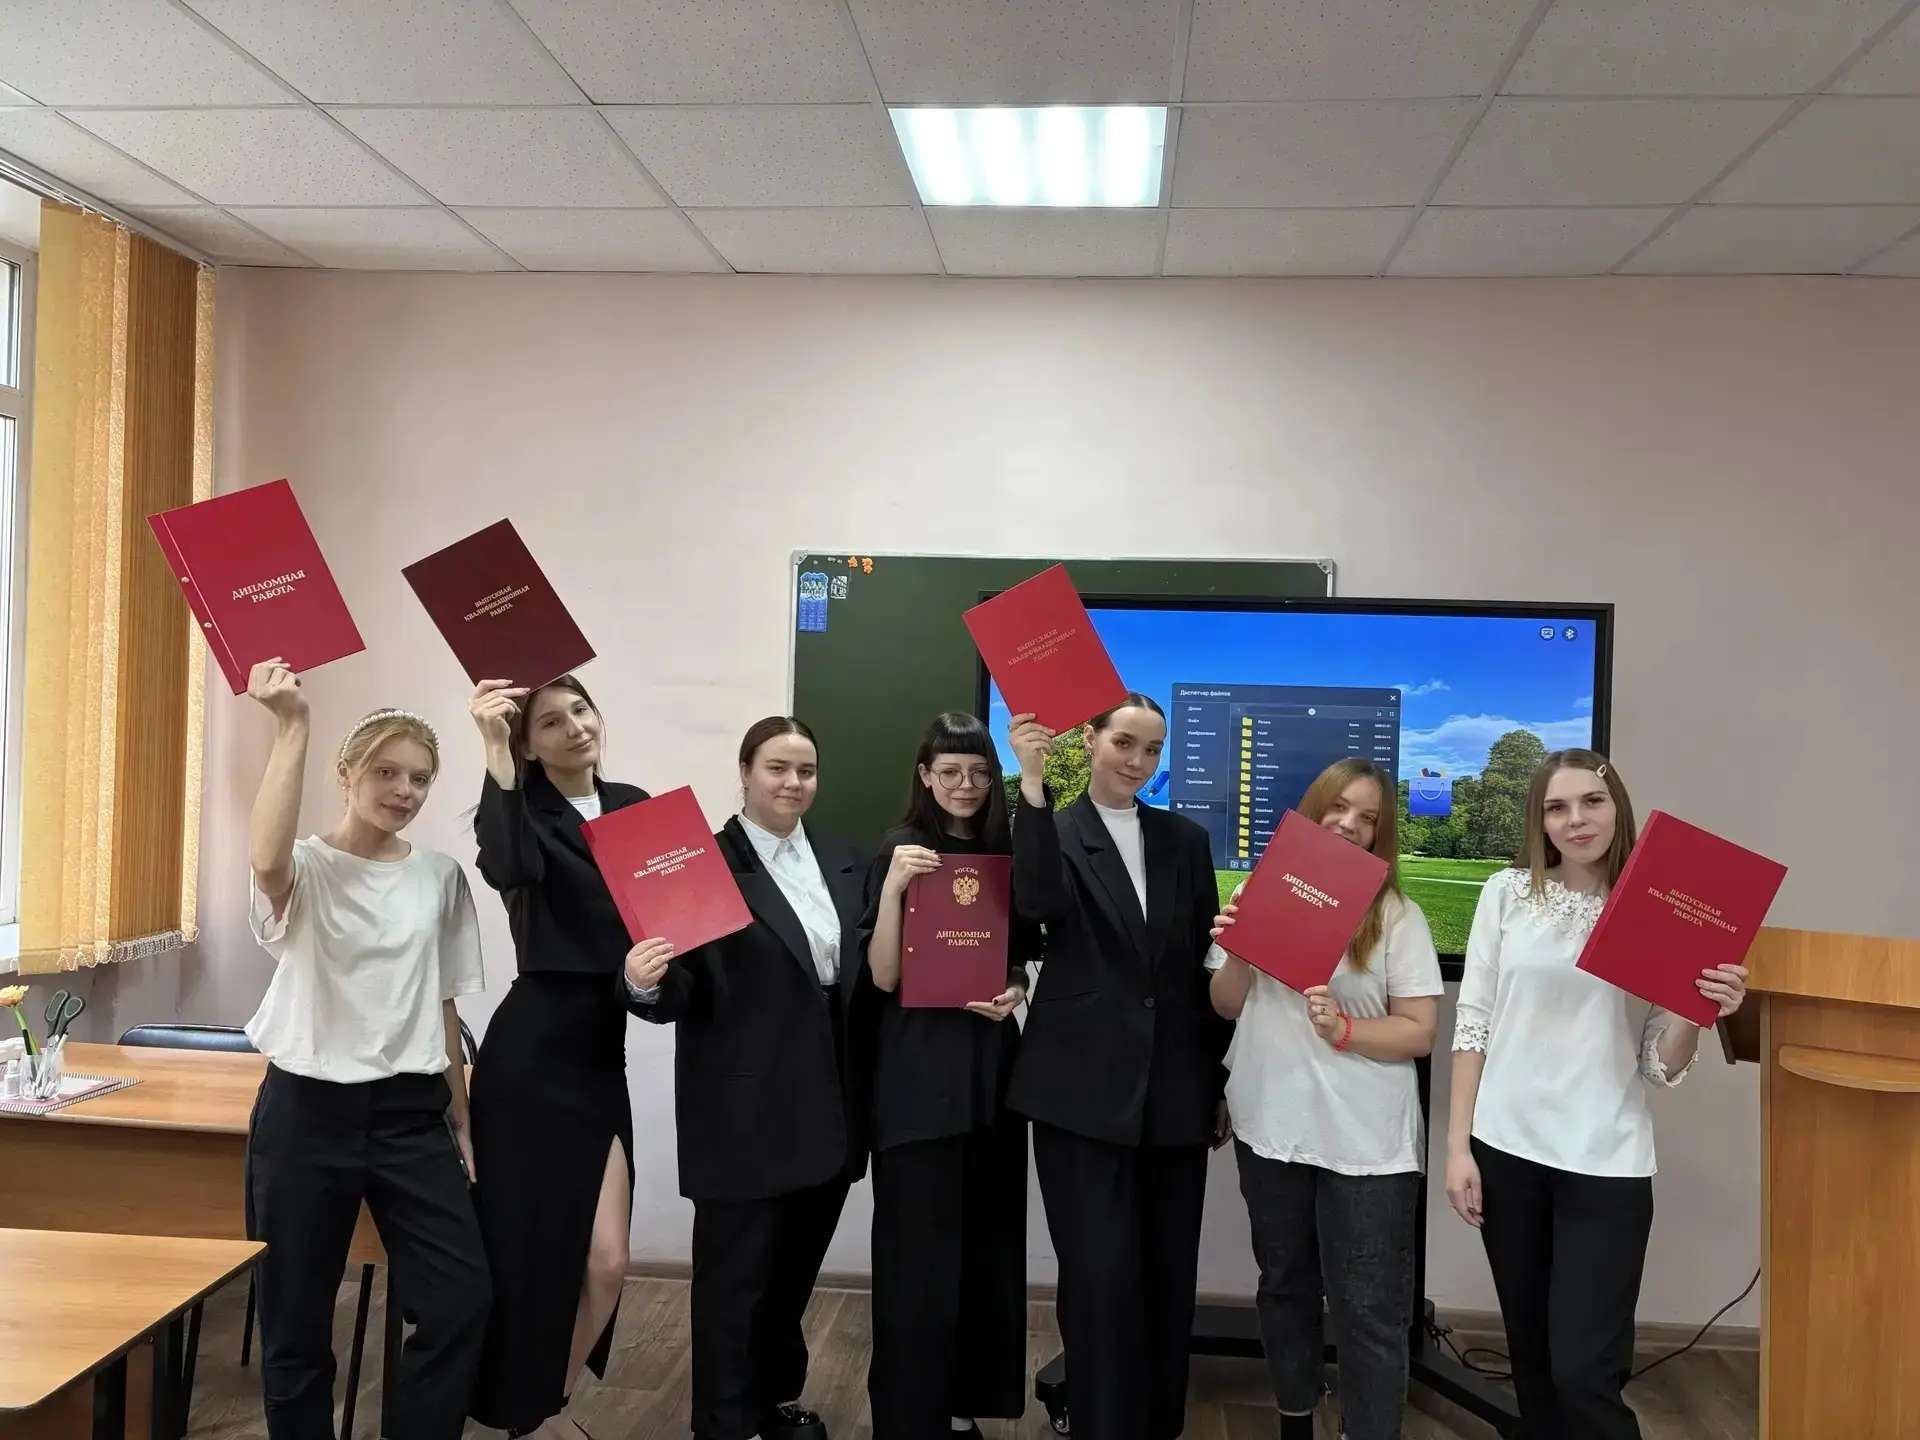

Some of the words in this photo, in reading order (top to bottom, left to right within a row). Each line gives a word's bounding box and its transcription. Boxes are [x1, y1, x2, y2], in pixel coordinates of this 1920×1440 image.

[231, 569, 307, 601] ДИПЛОМНАЯ
[250, 584, 296, 603] РАБОТА
[474, 585, 512, 608] ВЫПУСКНАЯ
[489, 602, 514, 618] РАБОТА
[633, 847, 706, 879] КВАЛИФИКАЦИОННАЯ
[645, 846, 688, 867] ВЫПУСКНАЯ
[660, 862, 686, 877] РАБОТА
[954, 866, 979, 876] РОССИЯ
[1281, 872, 1340, 908] ДИПЛОМНАЯ
[1290, 885, 1323, 909] РАБОТА
[1647, 886, 1739, 934] КВАЛИФИКАЦИОННАЯ
[1669, 888, 1722, 917] ВЫПУСКНАЯ
[1672, 907, 1703, 928] РАБОТА
[935, 930, 992, 940] ДИПЛОМНАЯ
[947, 939, 980, 947] РАБОТА
